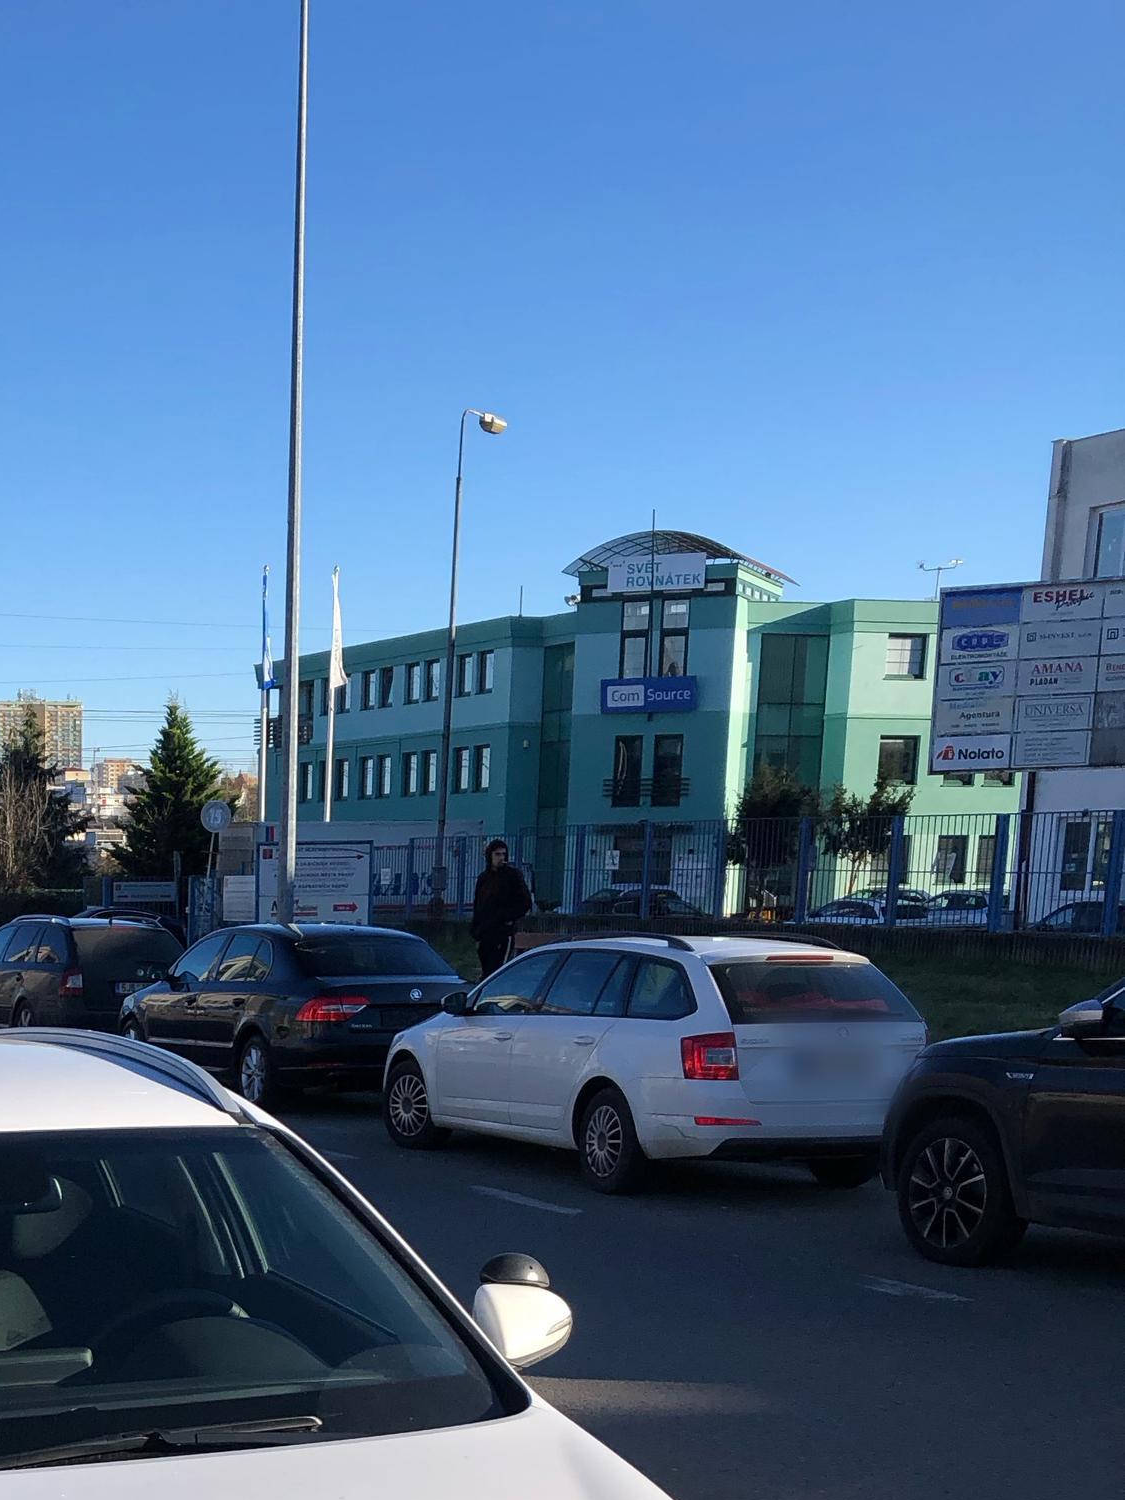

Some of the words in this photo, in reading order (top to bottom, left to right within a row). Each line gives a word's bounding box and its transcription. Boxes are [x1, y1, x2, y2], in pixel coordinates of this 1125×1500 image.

[626, 560, 662, 575] SVĚT
[626, 573, 701, 587] ROVNÁTEK
[1031, 662, 1084, 674] AMANA
[611, 689, 640, 702] Com
[647, 688, 691, 701] Source
[959, 711, 1001, 720] Agentura
[958, 747, 1005, 760] Nolato
